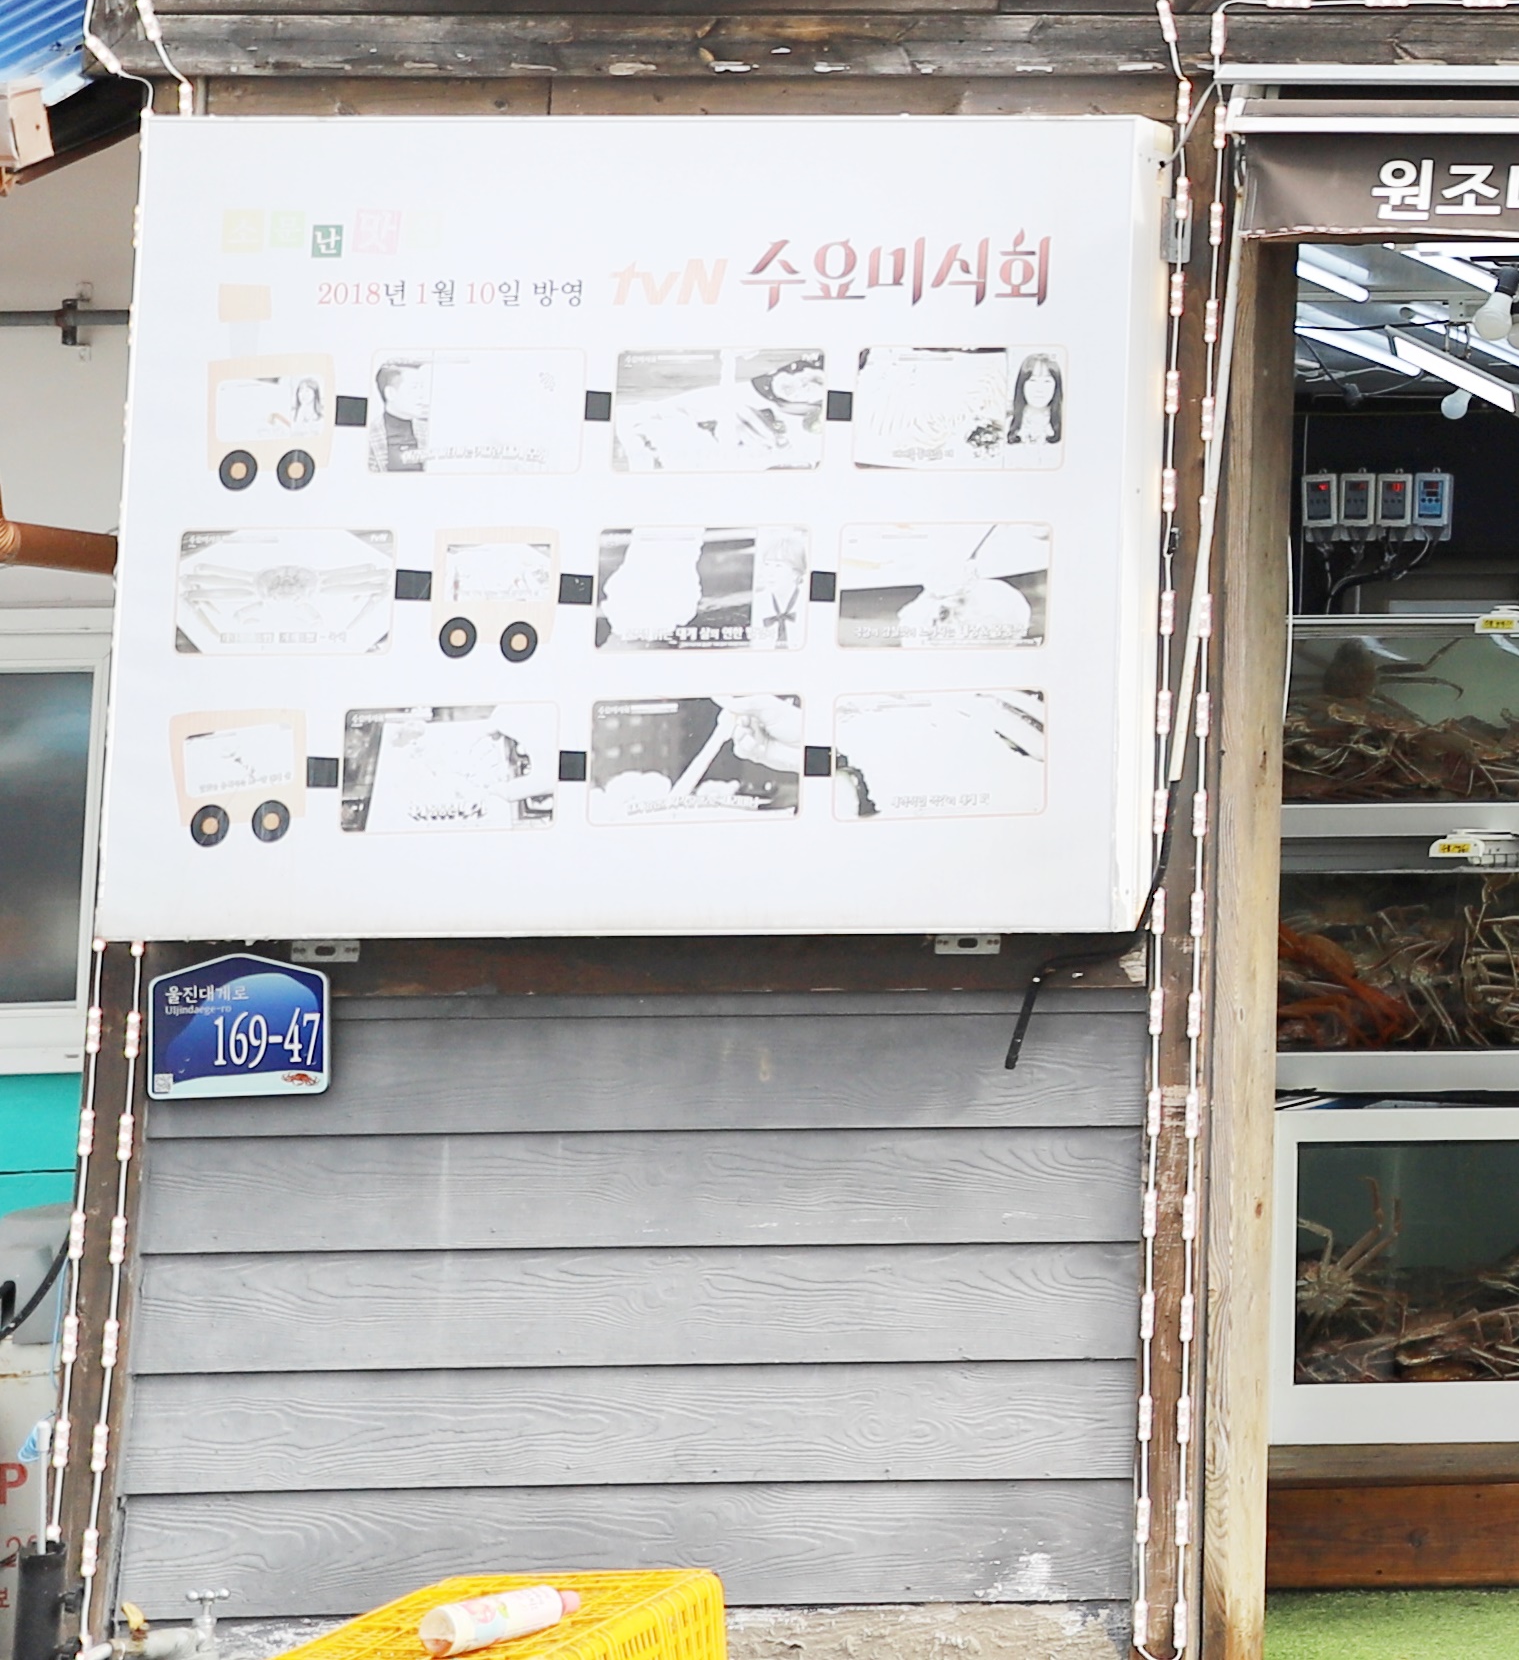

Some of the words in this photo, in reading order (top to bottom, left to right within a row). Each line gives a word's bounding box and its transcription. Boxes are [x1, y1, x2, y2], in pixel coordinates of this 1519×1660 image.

[609, 259, 729, 306] tvN
[739, 227, 1052, 312] 수요미식회
[316, 278, 407, 308] 2018년
[415, 278, 456, 308] 1월
[465, 278, 521, 308] 10일
[533, 278, 584, 308] 방영
[164, 984, 249, 1005] 울진대게로
[213, 1006, 321, 1068] 169-47
